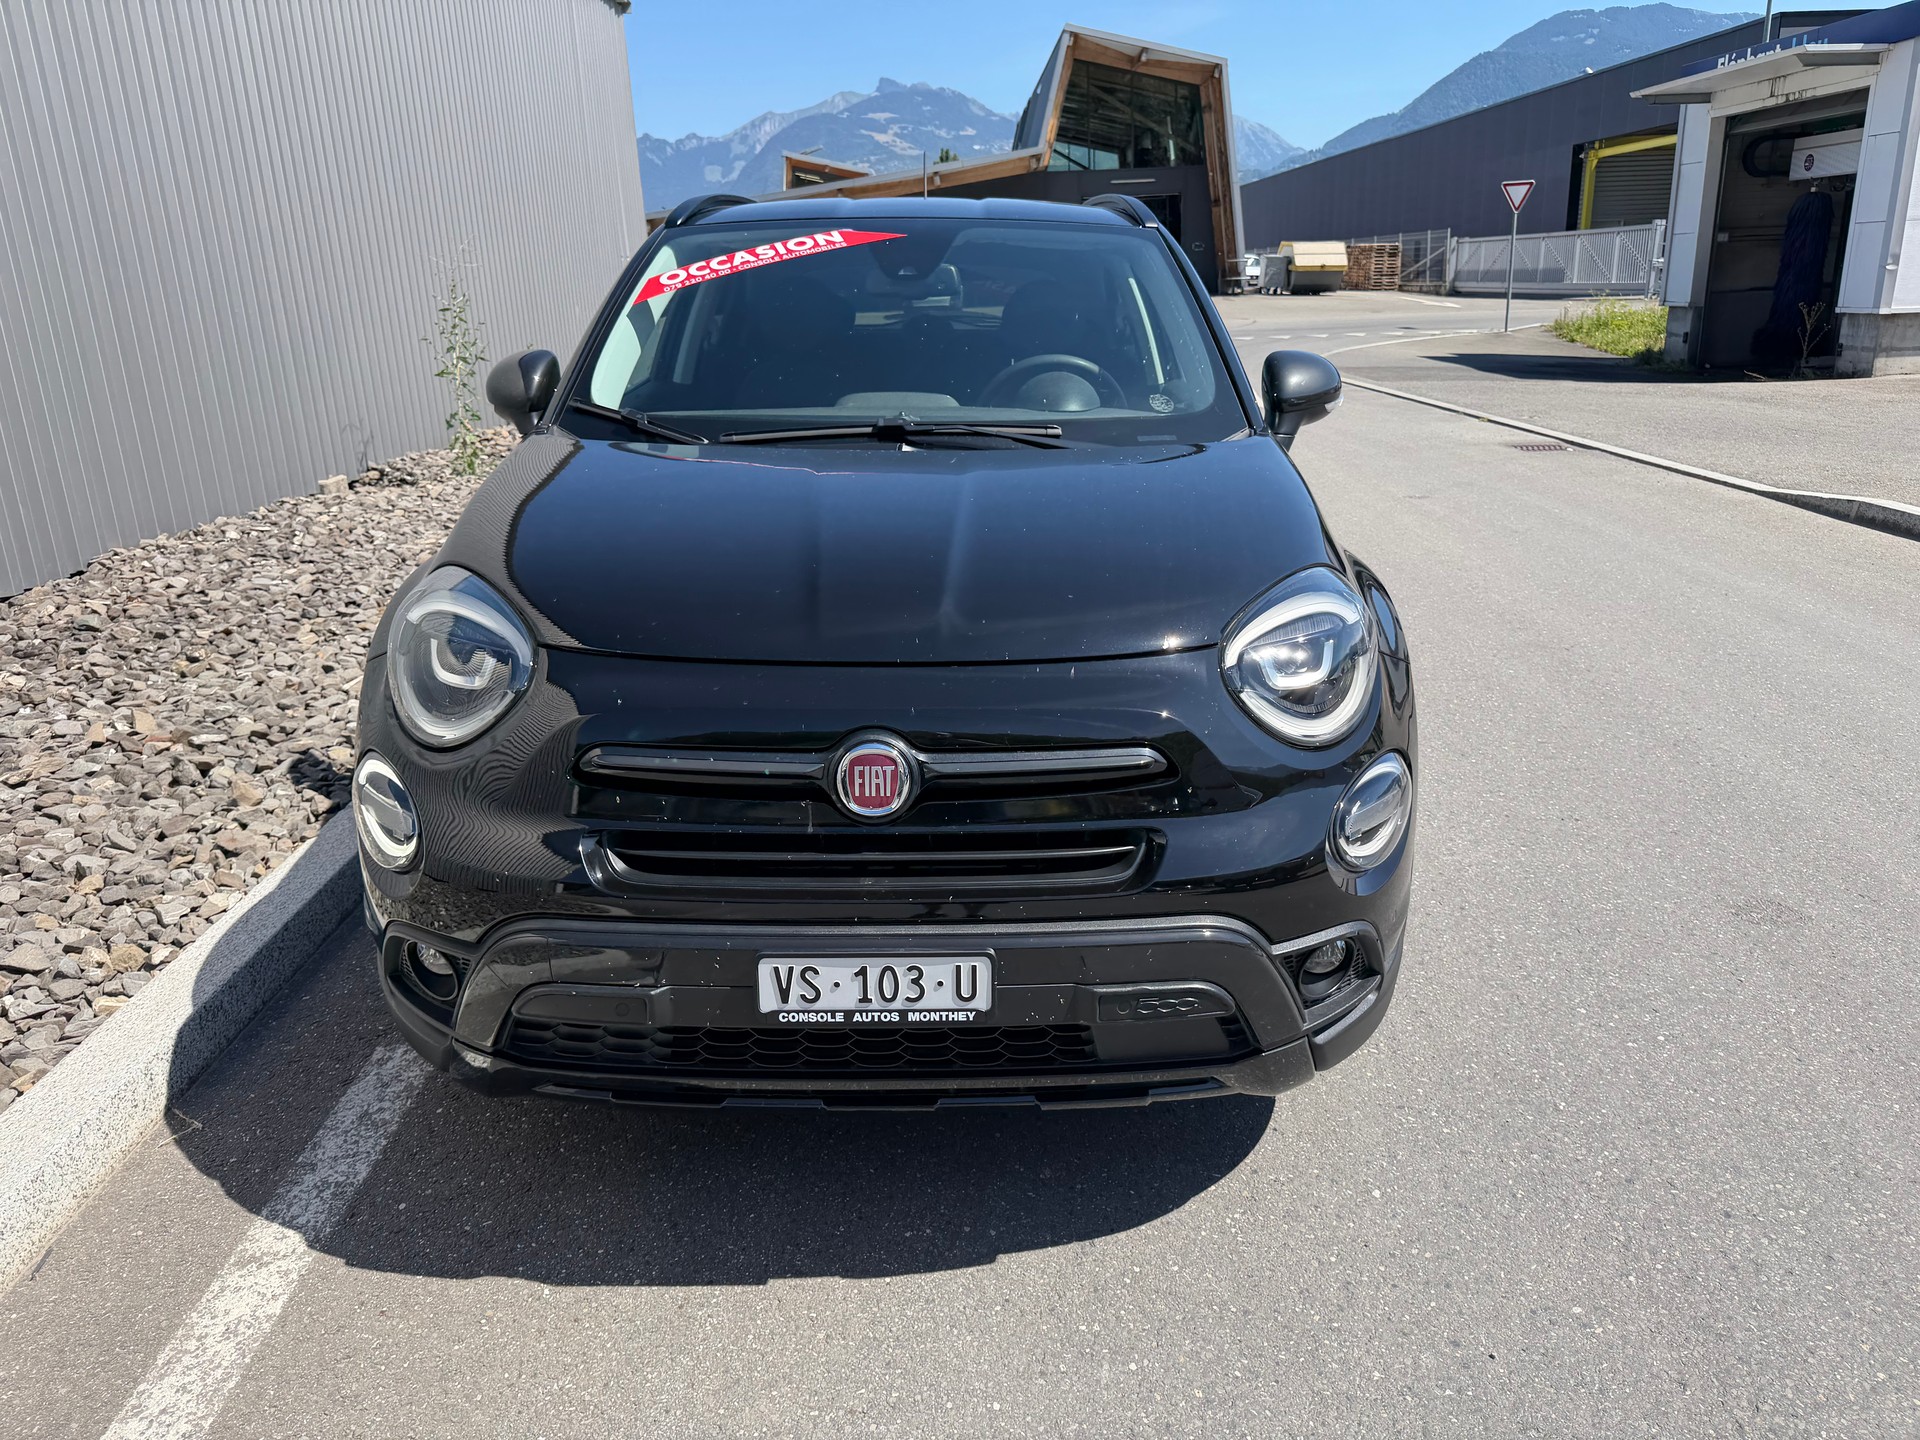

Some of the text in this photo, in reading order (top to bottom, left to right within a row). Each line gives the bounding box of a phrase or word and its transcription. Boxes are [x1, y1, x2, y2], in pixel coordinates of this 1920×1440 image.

[659, 230, 845, 285] OCCASION
[663, 282, 682, 292] 079
[684, 276, 703, 286] 220
[704, 272, 717, 280] 40
[718, 268, 731, 276] 00
[738, 256, 781, 270] CONSOLE
[782, 242, 848, 260] AUTOMOBILES
[853, 765, 895, 797] FIAT
[778, 1011, 976, 1023] CONSOLE AUTOS MONTHEY
